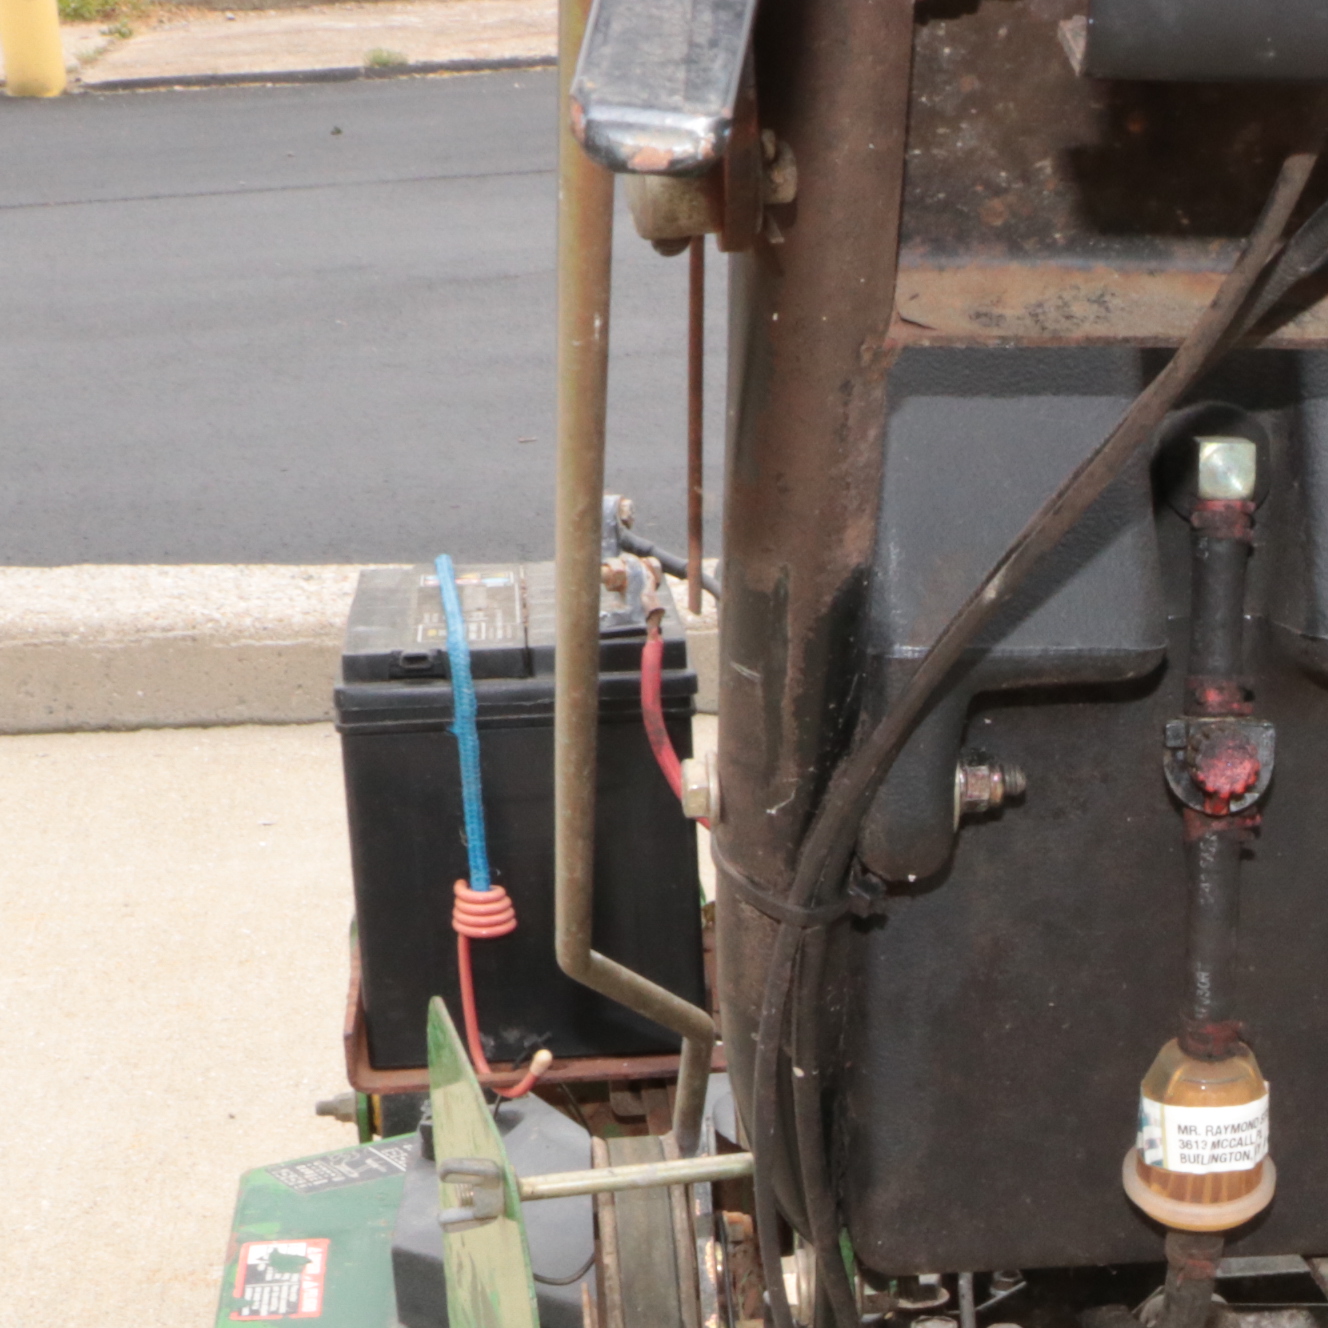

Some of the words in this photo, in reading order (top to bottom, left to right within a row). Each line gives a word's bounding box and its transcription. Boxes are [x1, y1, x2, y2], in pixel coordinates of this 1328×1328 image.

[1177, 1124, 1201, 1136] MR.
[1205, 1117, 1259, 1136] RAYMOND
[1210, 1134, 1255, 1150] MCCALL
